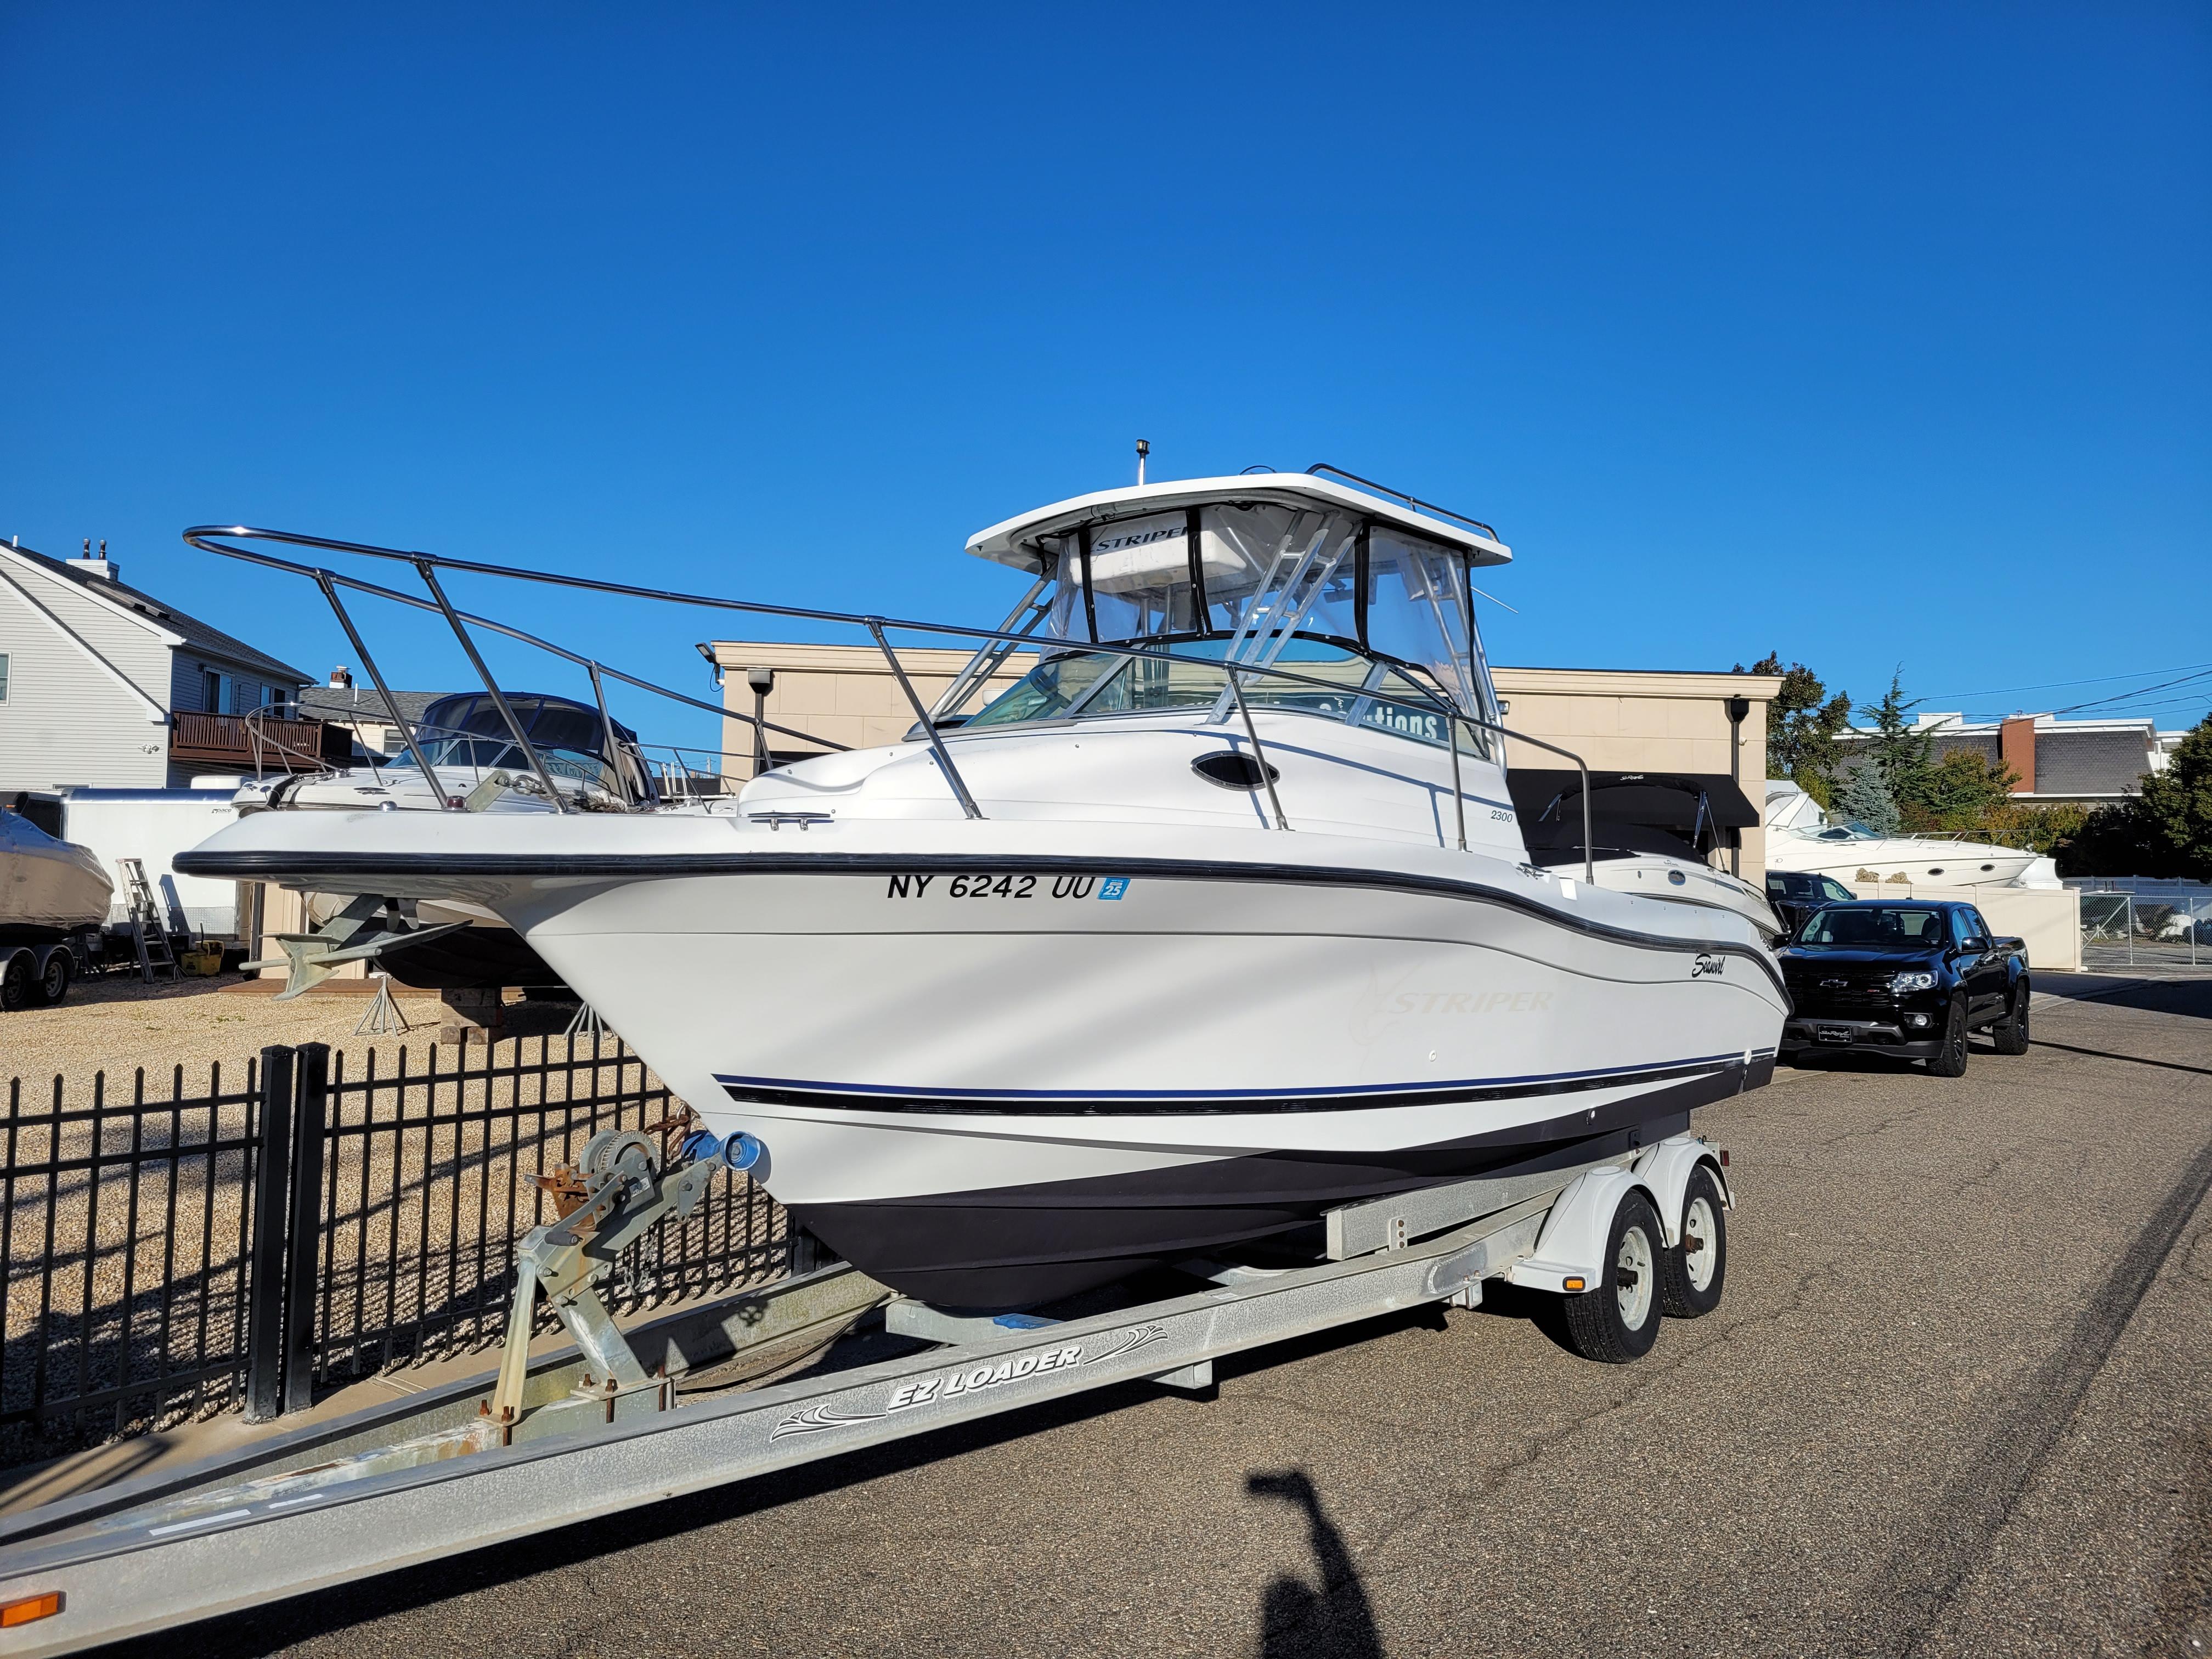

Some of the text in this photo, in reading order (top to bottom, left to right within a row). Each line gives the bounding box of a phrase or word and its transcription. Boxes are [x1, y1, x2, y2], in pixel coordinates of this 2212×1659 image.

[1490, 810, 1513, 823] 2300
[887, 874, 1096, 899] NY 6242 UU
[1102, 884, 1122, 896] 25
[1384, 991, 1554, 1014] STRIPER
[888, 1346, 1083, 1410] EZ LOADER
